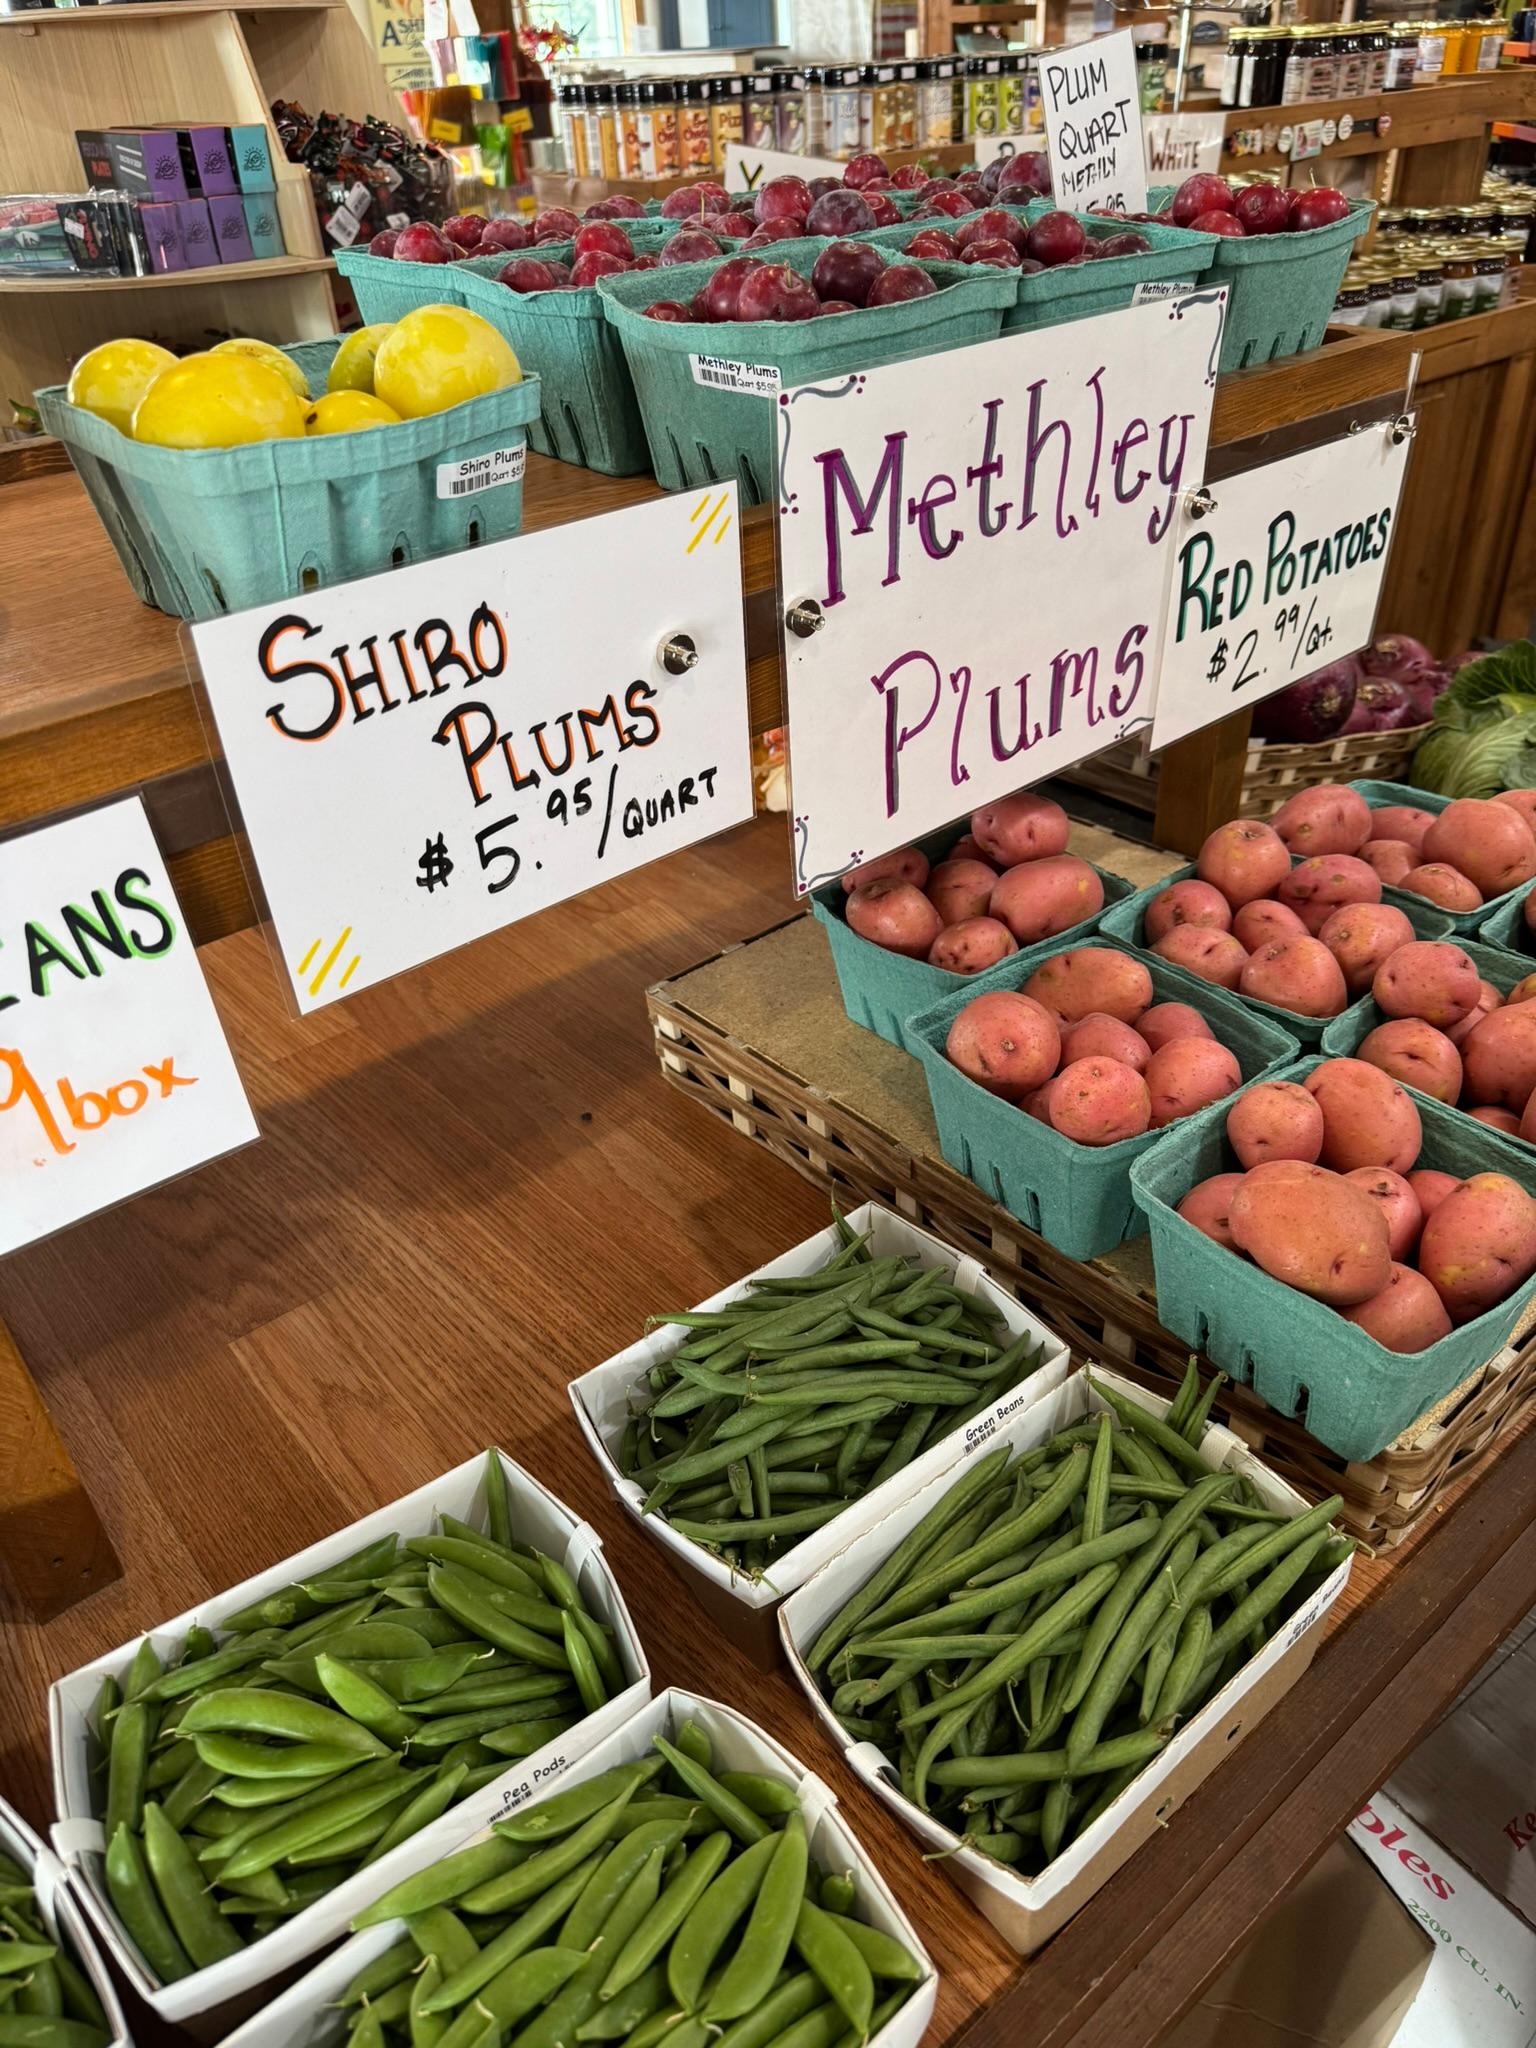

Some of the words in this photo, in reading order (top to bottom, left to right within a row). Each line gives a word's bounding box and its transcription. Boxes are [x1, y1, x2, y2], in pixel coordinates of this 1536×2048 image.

[1047, 58, 1107, 112] PLUM
[1059, 98, 1131, 160] QUART
[1149, 128, 1200, 171] WHITE
[698, 354, 741, 375] Methley
[745, 362, 778, 379] Plums
[459, 459, 490, 476] Shiro
[494, 448, 523, 466] Plums
[813, 367, 1196, 608] Methley
[1175, 531, 1253, 642] RED
[1263, 507, 1391, 605] POTATOES
[258, 601, 508, 743] SHIRO
[431, 679, 662, 808] PLUMS
[871, 624, 1148, 819] Plums
[0, 867, 176, 1010] ANS
[965, 1416, 996, 1441] Green
[996, 1395, 1025, 1420] Beans
[503, 1781, 529, 1803] Pea
[533, 1755, 566, 1782] Pods
[1406, 1898, 1452, 1944] 2200
[1455, 1945, 1489, 1982] CU.
[1495, 1984, 1525, 2016] IN.
